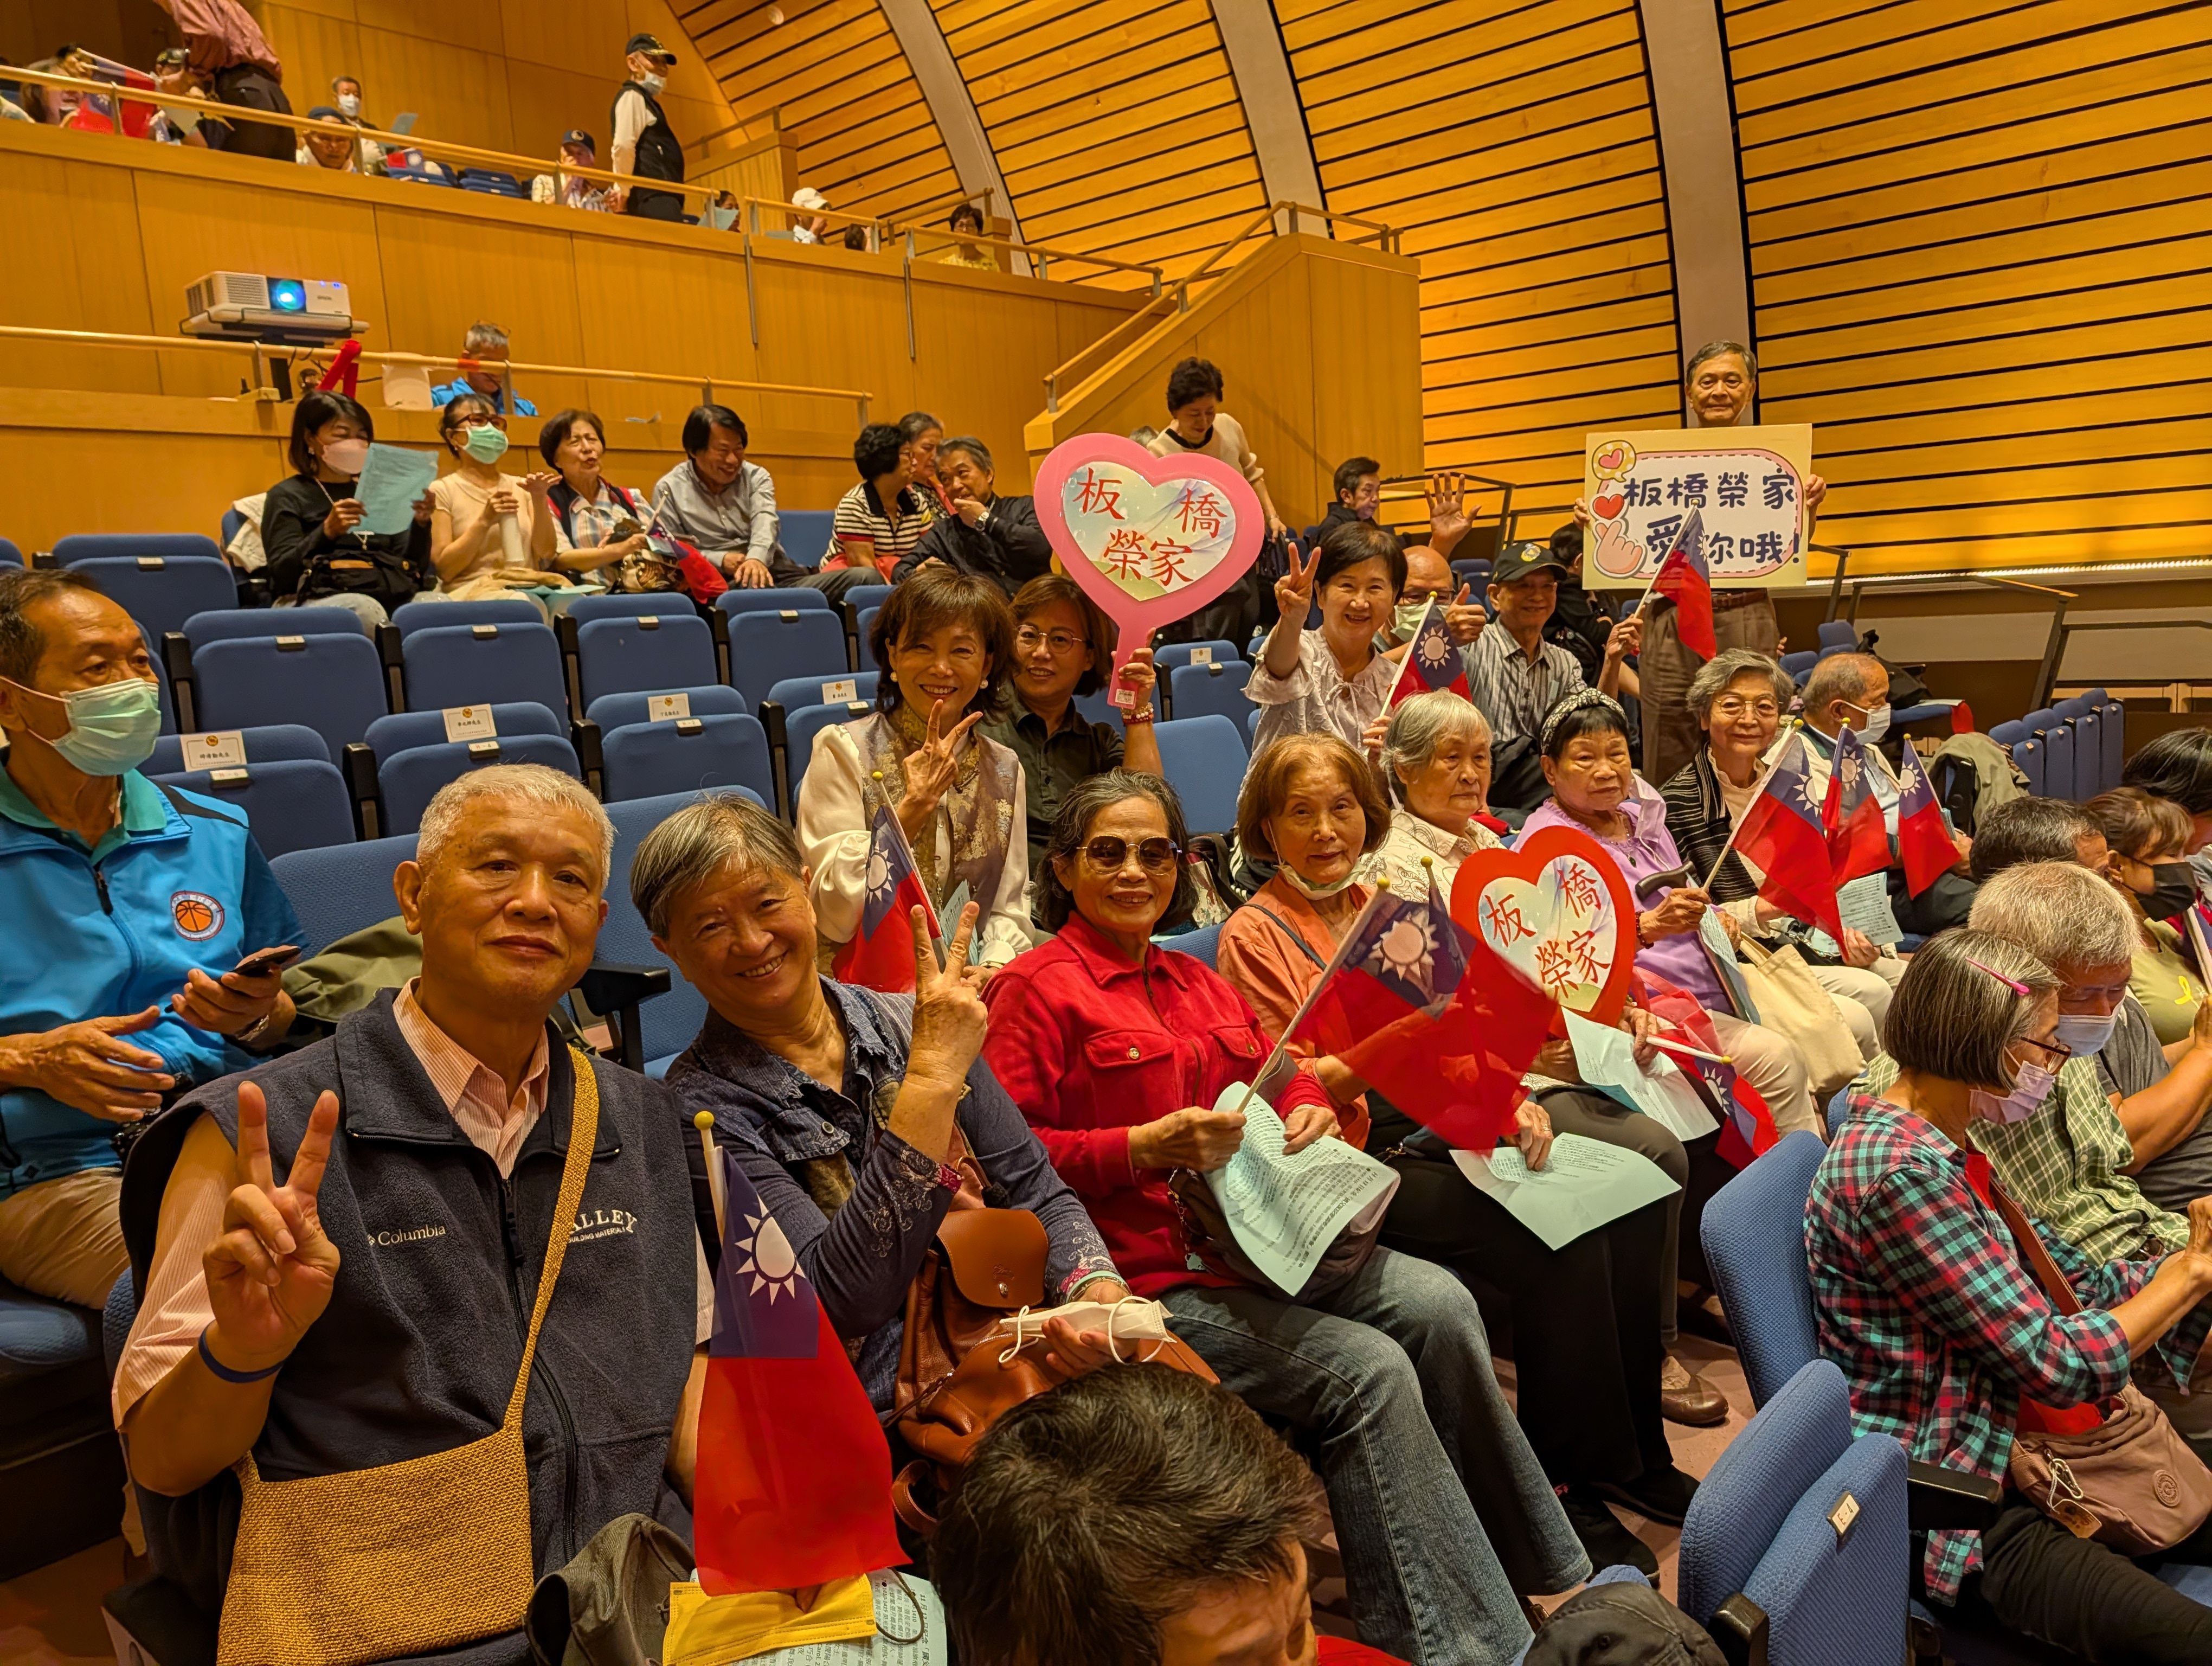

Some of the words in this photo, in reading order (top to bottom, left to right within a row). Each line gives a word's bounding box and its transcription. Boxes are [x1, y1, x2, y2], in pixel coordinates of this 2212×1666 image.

[1624, 467, 1795, 510] 板橋榮家
[1103, 528, 1194, 587] 榮家
[1534, 930, 1611, 1000] 榮家
[377, 1223, 446, 1246] Columbia
[569, 1209, 638, 1234] ALLEY
[595, 1226, 626, 1239] MATERIALS
